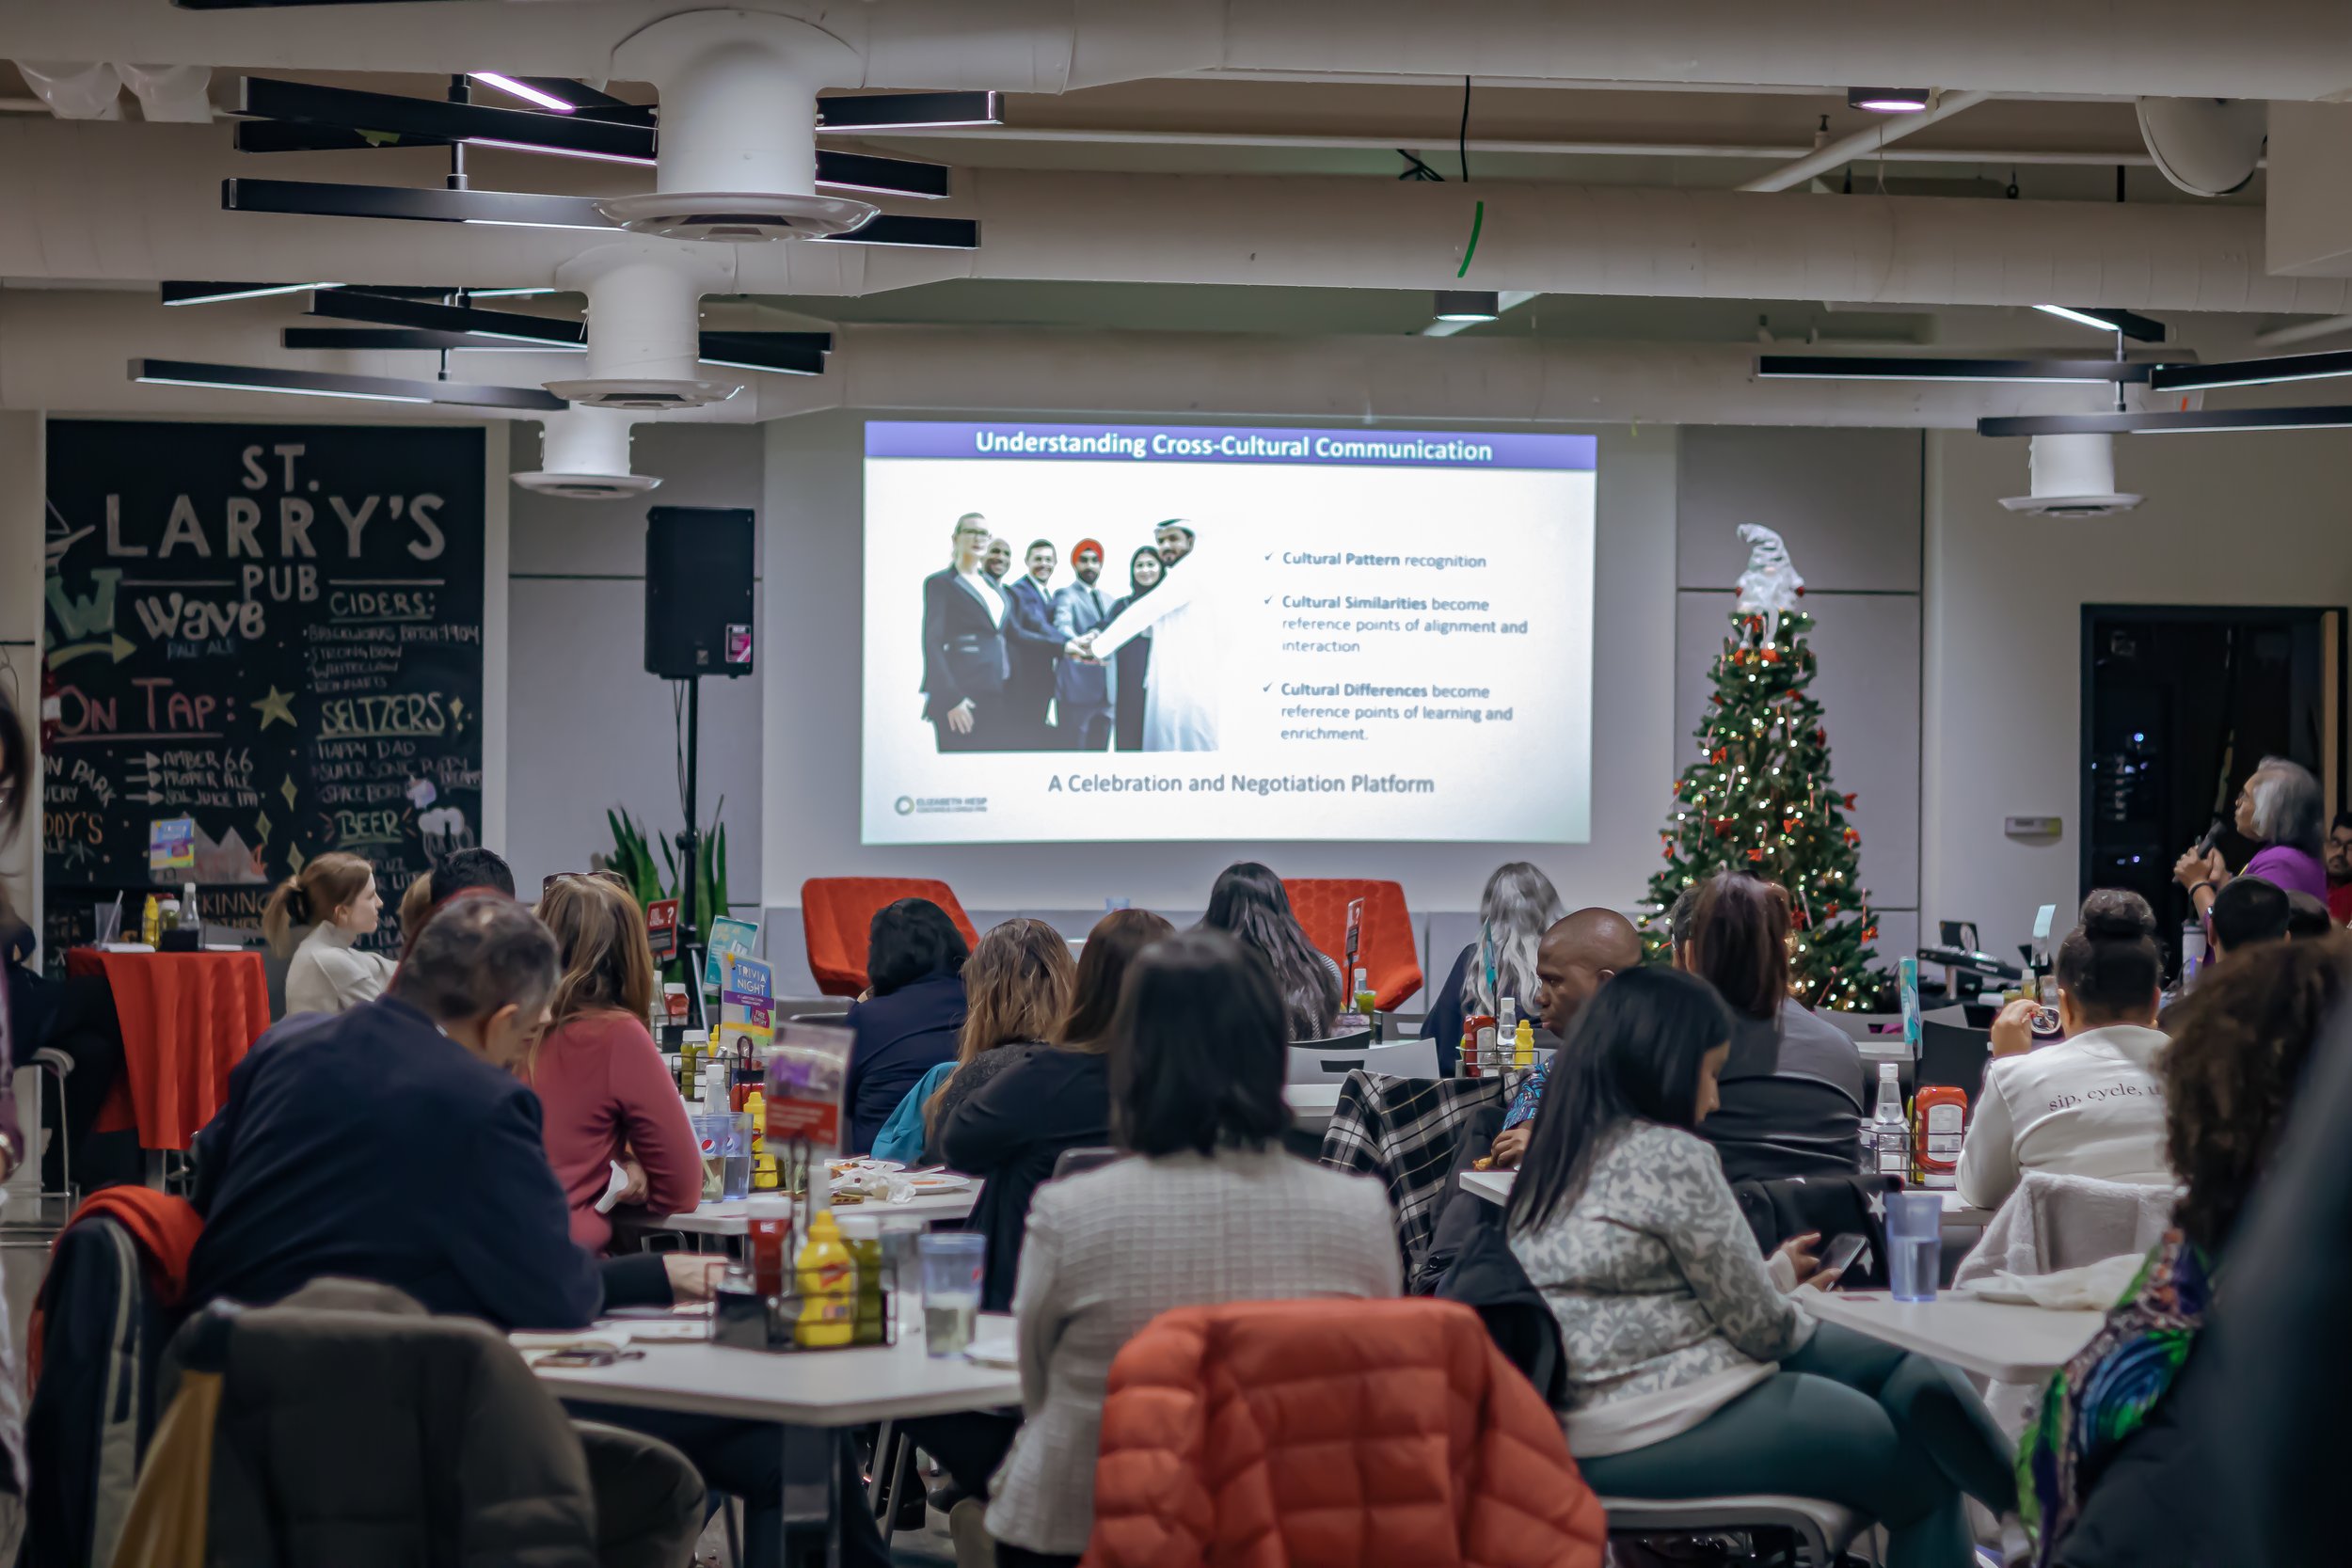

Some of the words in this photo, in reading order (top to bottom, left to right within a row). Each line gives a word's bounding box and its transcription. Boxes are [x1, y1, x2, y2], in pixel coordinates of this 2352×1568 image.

[976, 431, 1147, 459] Understanding
[1152, 434, 1309, 457] Cross-Cultural
[1315, 437, 1493, 461] Communication
[242, 444, 320, 492] ST.
[106, 494, 446, 560] LARRY'S
[1282, 551, 1341, 565] Cultural
[1345, 552, 1400, 566] Pattern
[1405, 554, 1486, 570] recognition
[243, 564, 320, 603] PUB
[329, 591, 436, 616] CIDERS:
[1282, 595, 1341, 610] Cultural
[1345, 596, 1427, 610] Similarities
[1432, 597, 1489, 611] become
[135, 592, 267, 641] Wave
[1282, 618, 1351, 631] reference
[1356, 619, 1400, 634] points
[1405, 619, 1420, 631] of
[1424, 619, 1497, 635] alignment
[1501, 620, 1529, 634] and
[1282, 640, 1360, 653] interaction
[1280, 683, 1340, 696] Cultural
[1343, 683, 1428, 697] Differences
[1432, 685, 1490, 698] become
[1280, 704, 1350, 718] reference
[1355, 705, 1400, 721] points
[1404, 705, 1419, 719] of
[1423, 706, 1482, 722] learning
[1486, 706, 1513, 721] and
[1280, 727, 1369, 741] enrichment.
[1048, 776, 1062, 792] A
[1068, 774, 1183, 793] Celebration
[1188, 774, 1225, 793] and
[1232, 775, 1345, 796] Negotiation
[1351, 774, 1435, 793] Platform
[737, 964, 767, 983] TRIVIA
[737, 979, 766, 996] NIGHT
[2048, 1095, 2082, 1112] sip,
[2087, 1083, 2143, 1101] cycle,
